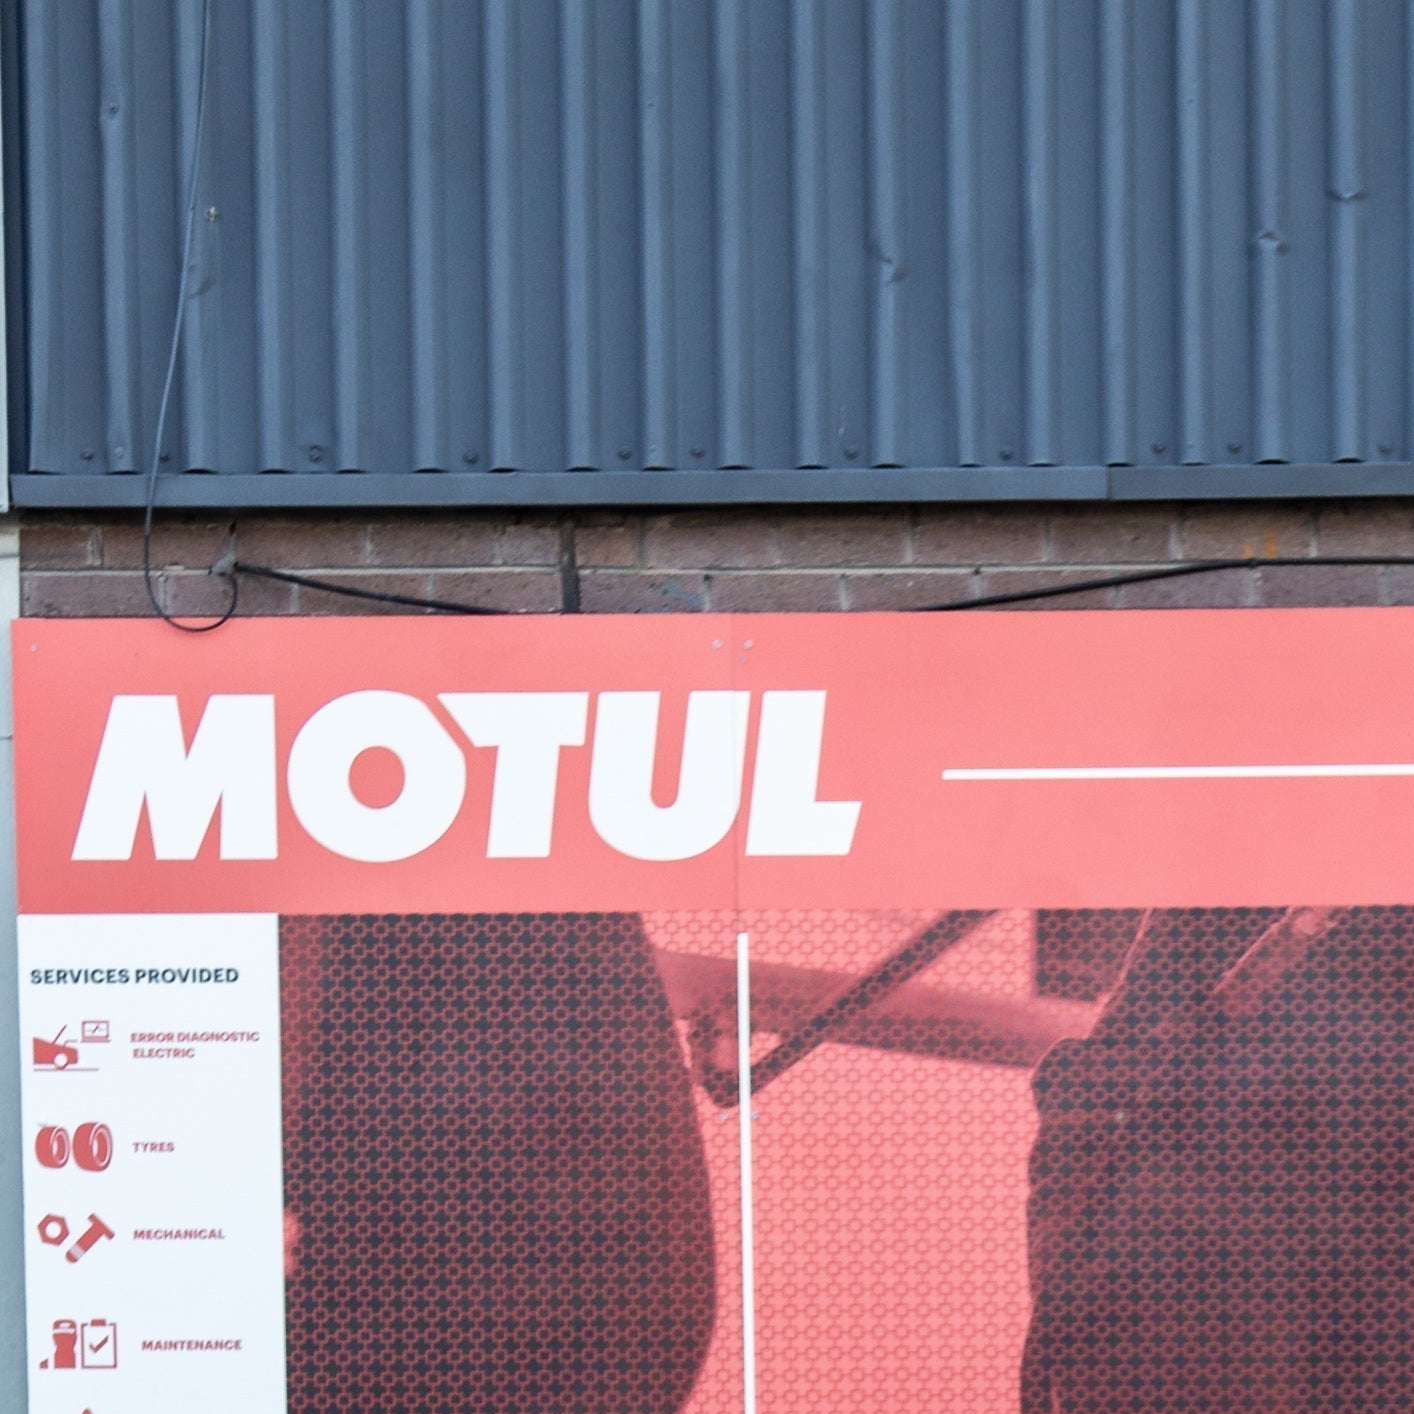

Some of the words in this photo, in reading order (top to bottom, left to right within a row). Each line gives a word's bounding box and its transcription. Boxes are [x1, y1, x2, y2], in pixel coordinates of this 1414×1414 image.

[71, 689, 862, 862] MOTUL
[29, 967, 131, 985] SERVICES
[134, 967, 240, 985] PROVIDED
[130, 1031, 175, 1044] ERROR
[176, 1031, 260, 1043] DIAGNOSTIC
[132, 1047, 196, 1059] ELECTRIC
[132, 1141, 176, 1153] TYRES
[133, 1228, 225, 1241] MECHANICAL
[141, 1338, 242, 1352] MAINTENANCE
